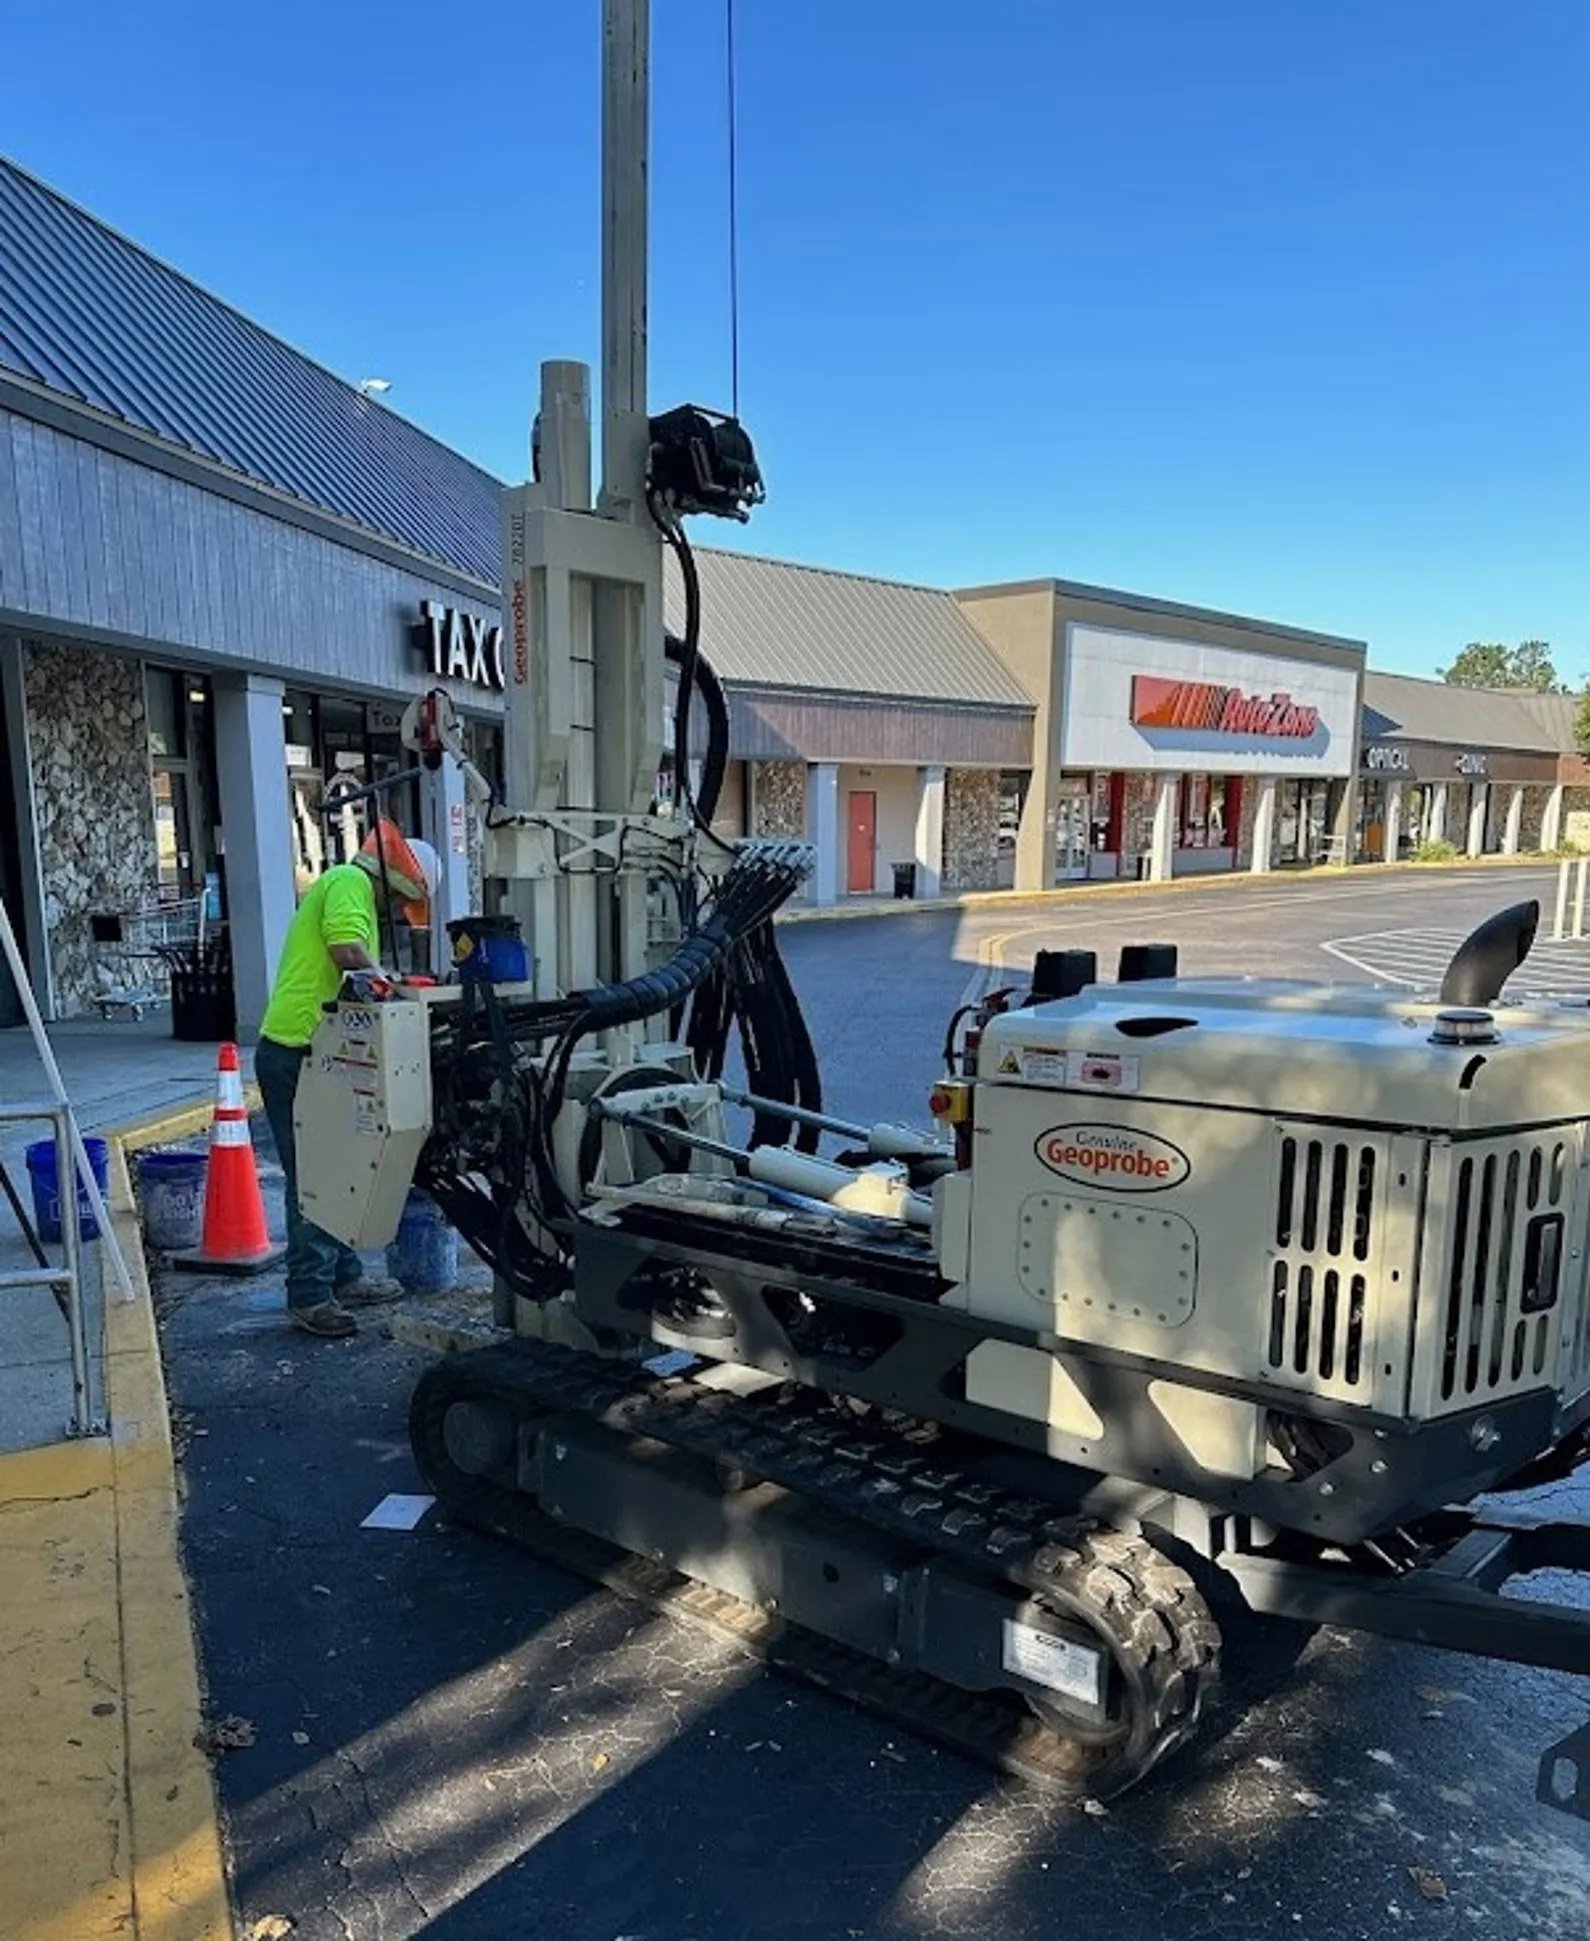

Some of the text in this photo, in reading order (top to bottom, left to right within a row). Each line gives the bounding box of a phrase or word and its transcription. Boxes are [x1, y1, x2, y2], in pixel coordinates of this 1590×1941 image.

[512, 581, 527, 684] Geoprobe
[1222, 688, 1318, 738] AutoZone
[1046, 1138, 1170, 1177] Geoprobe
